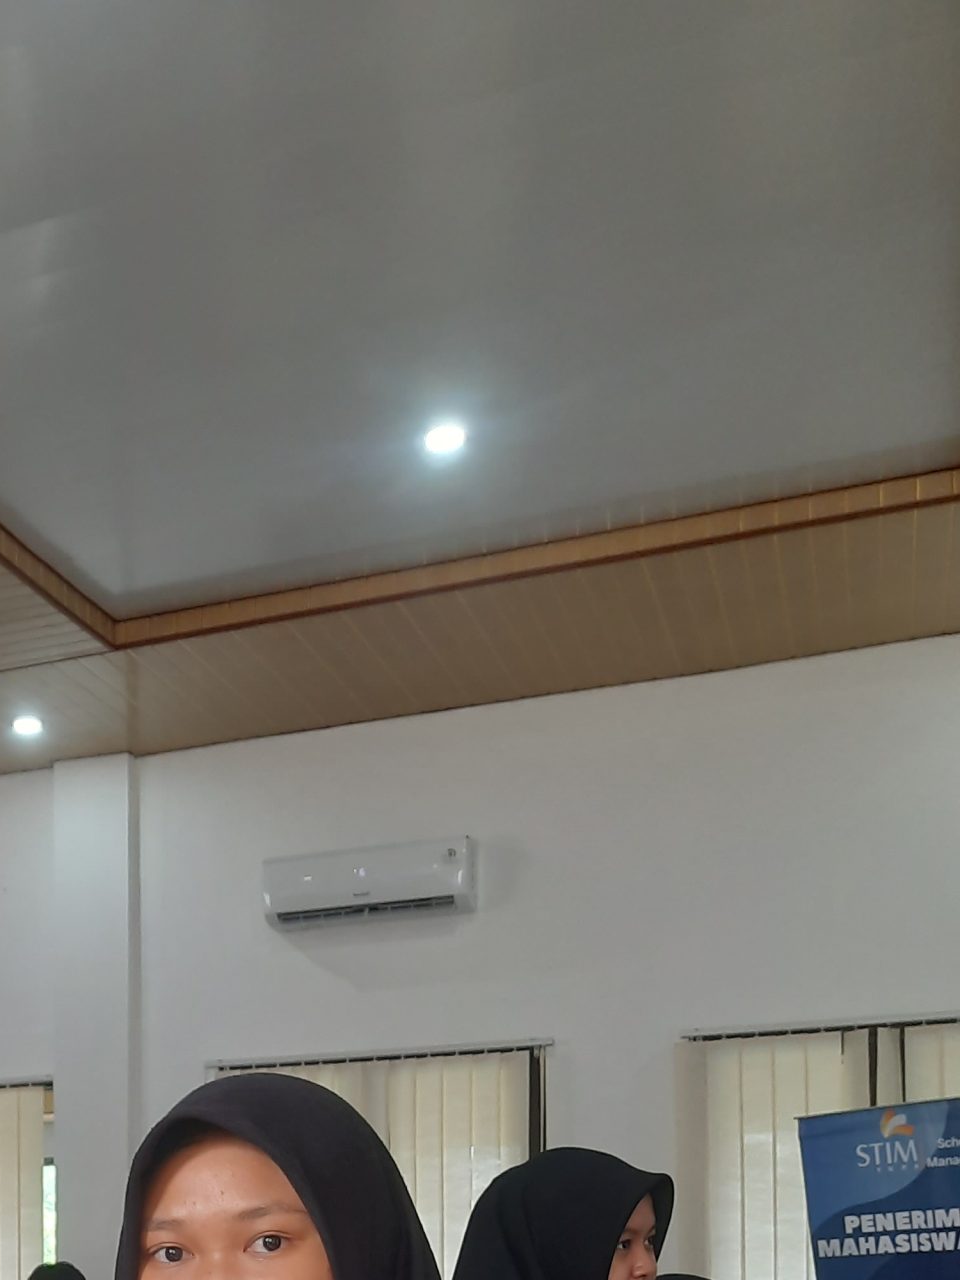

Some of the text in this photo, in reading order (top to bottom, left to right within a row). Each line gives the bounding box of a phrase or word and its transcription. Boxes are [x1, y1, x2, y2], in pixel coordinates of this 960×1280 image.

[855, 1139, 918, 1167] STIM
[937, 1136, 960, 1149] Sch
[844, 1207, 960, 1234] PENERIM
[817, 1231, 960, 1258] MAHASISW
